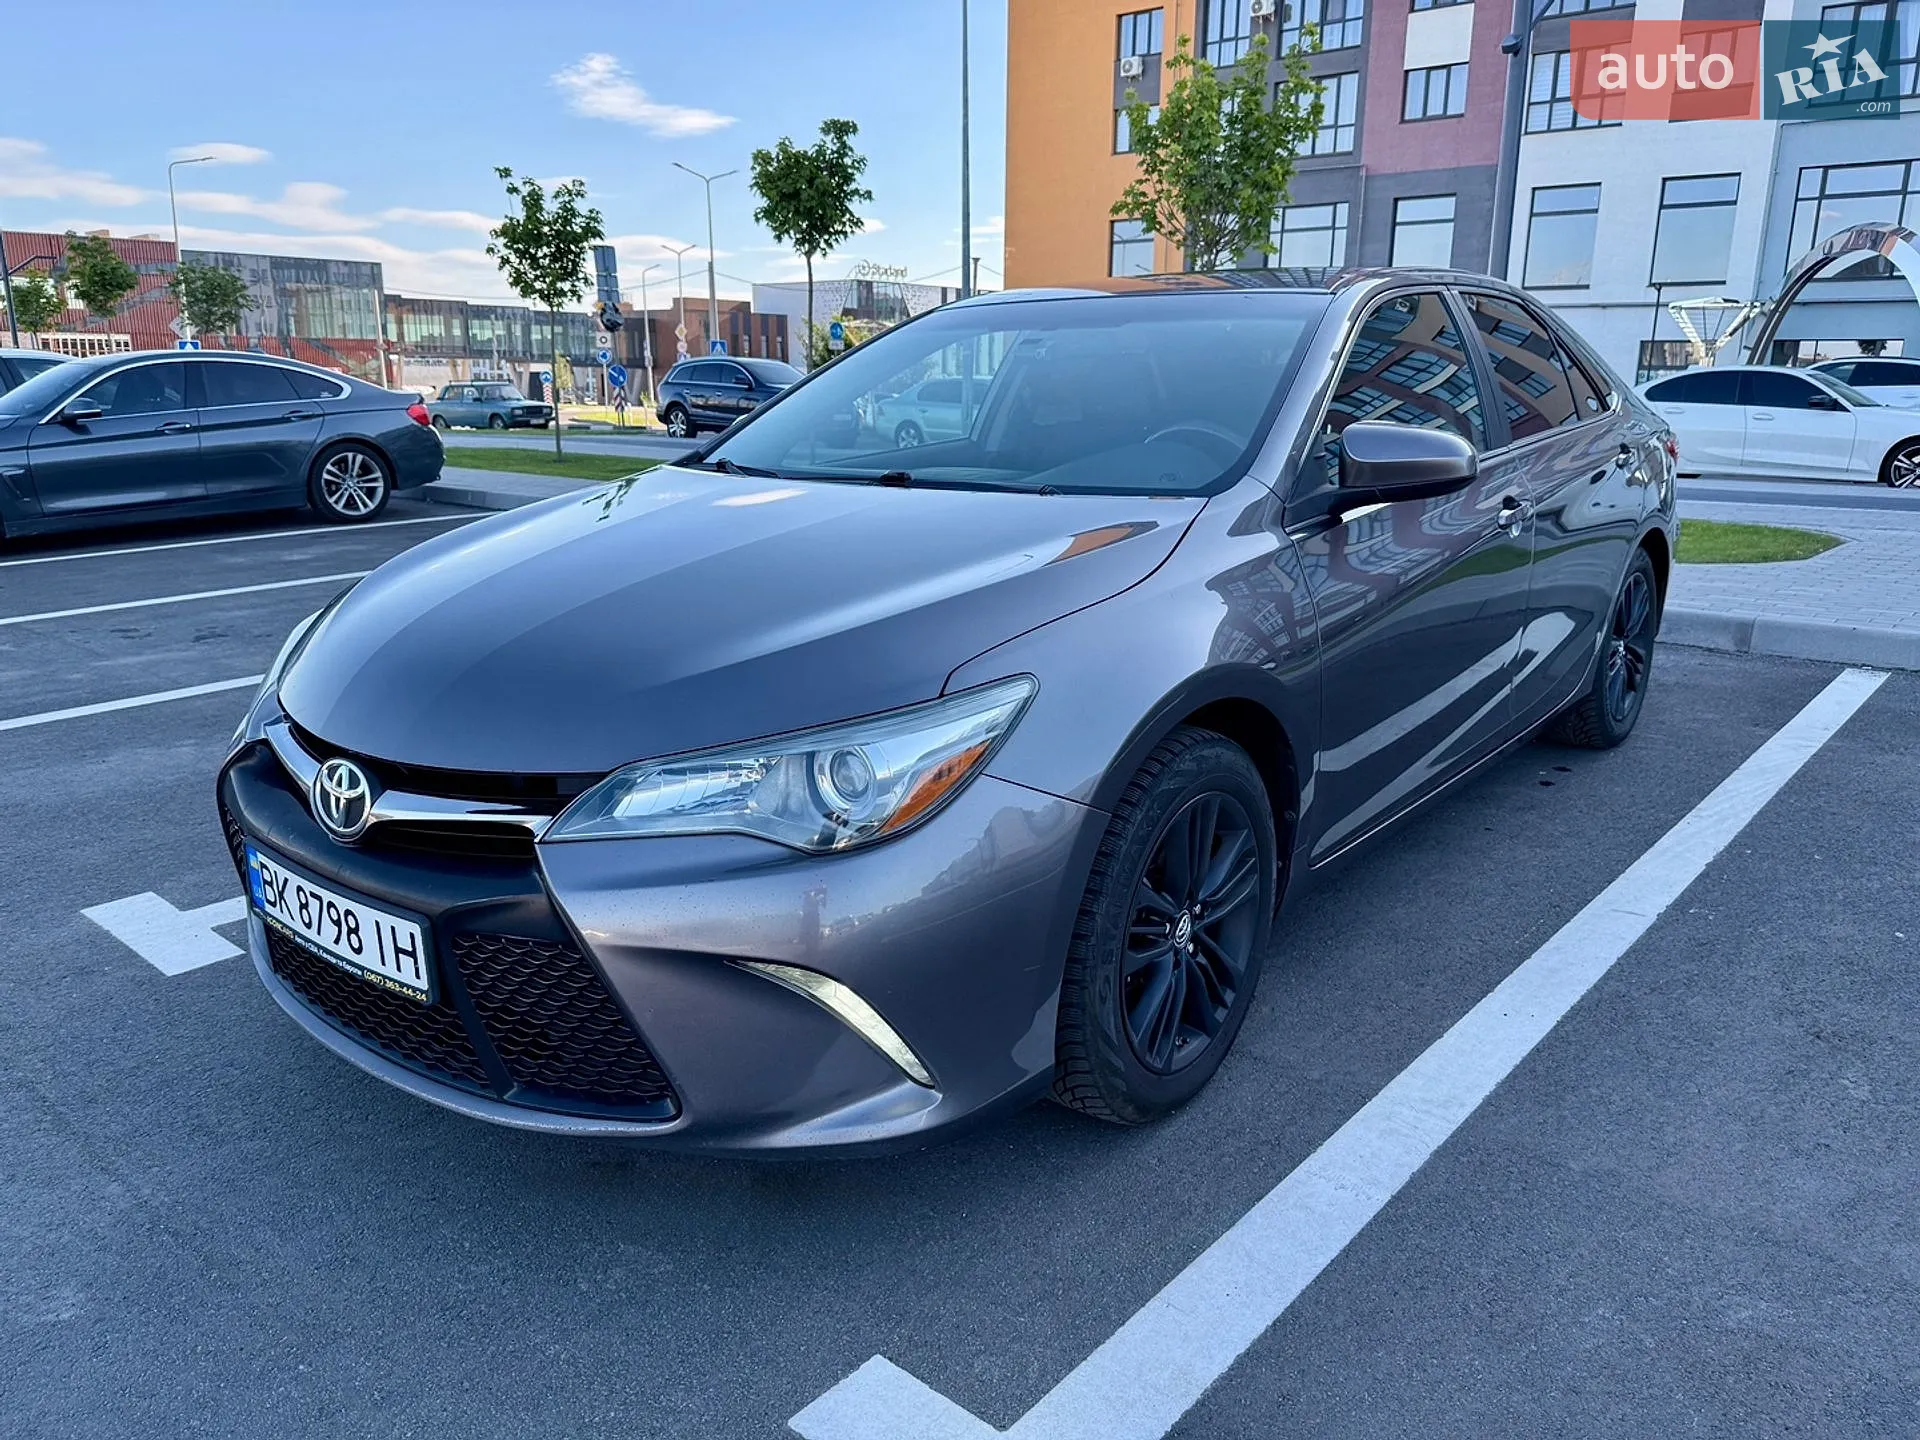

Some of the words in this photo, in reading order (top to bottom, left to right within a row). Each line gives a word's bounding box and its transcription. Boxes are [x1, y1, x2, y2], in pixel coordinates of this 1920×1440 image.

[259, 861, 295, 922] BK
[296, 884, 364, 956] 8798
[375, 919, 421, 980] IH
